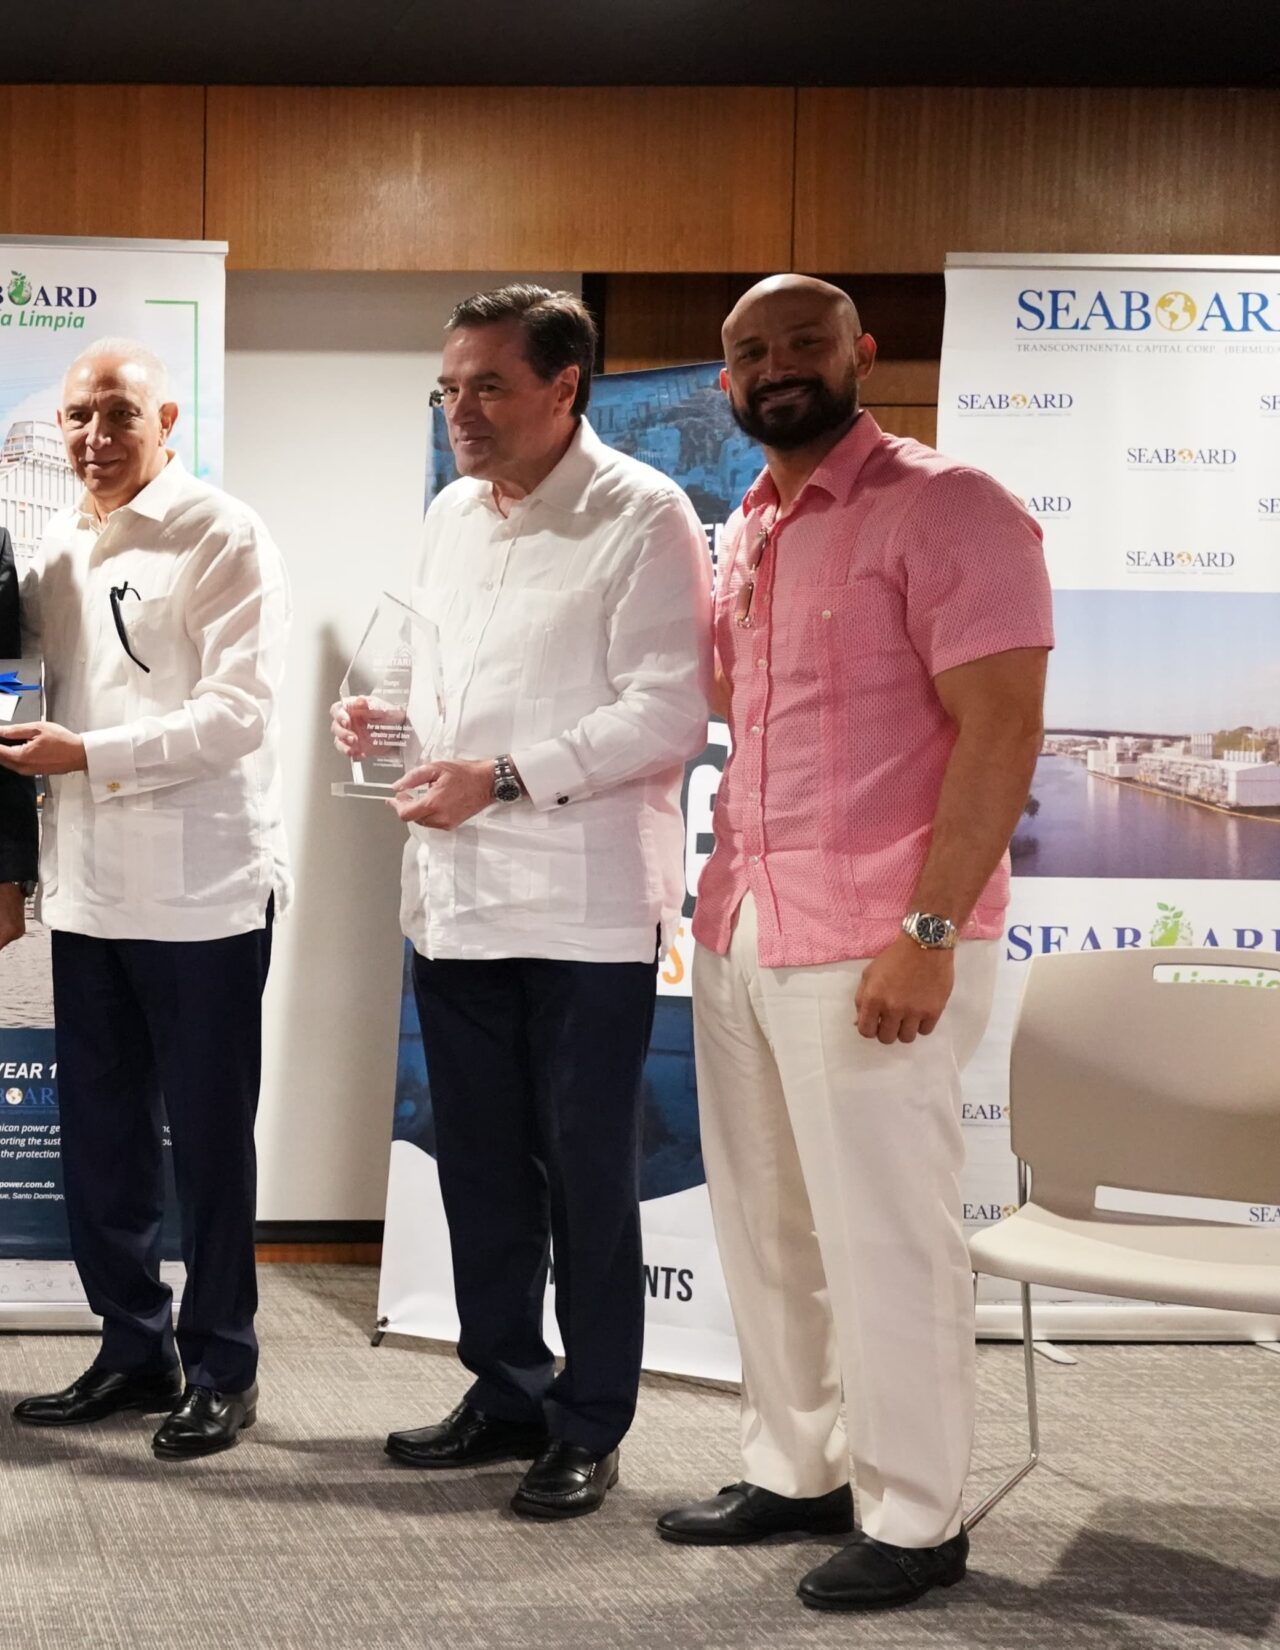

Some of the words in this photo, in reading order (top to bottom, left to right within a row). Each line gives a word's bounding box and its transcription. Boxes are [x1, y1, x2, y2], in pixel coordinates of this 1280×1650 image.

[1016, 289, 1280, 332] SEABOAR
[18, 310, 85, 332] Limpia
[1016, 343, 1132, 353] TRANSCONTINENTAL
[1136, 344, 1183, 354] CAPITAL
[957, 393, 1073, 410] SEABOARD
[1127, 448, 1236, 464] SEABOARD
[1126, 551, 1235, 568] SEABOARD
[1007, 925, 1280, 961] SEABOAR
[21, 1125, 49, 1134] power
[27, 1137, 41, 1145] the
[1, 1150, 15, 1158] the
[16, 1150, 60, 1160] protection
